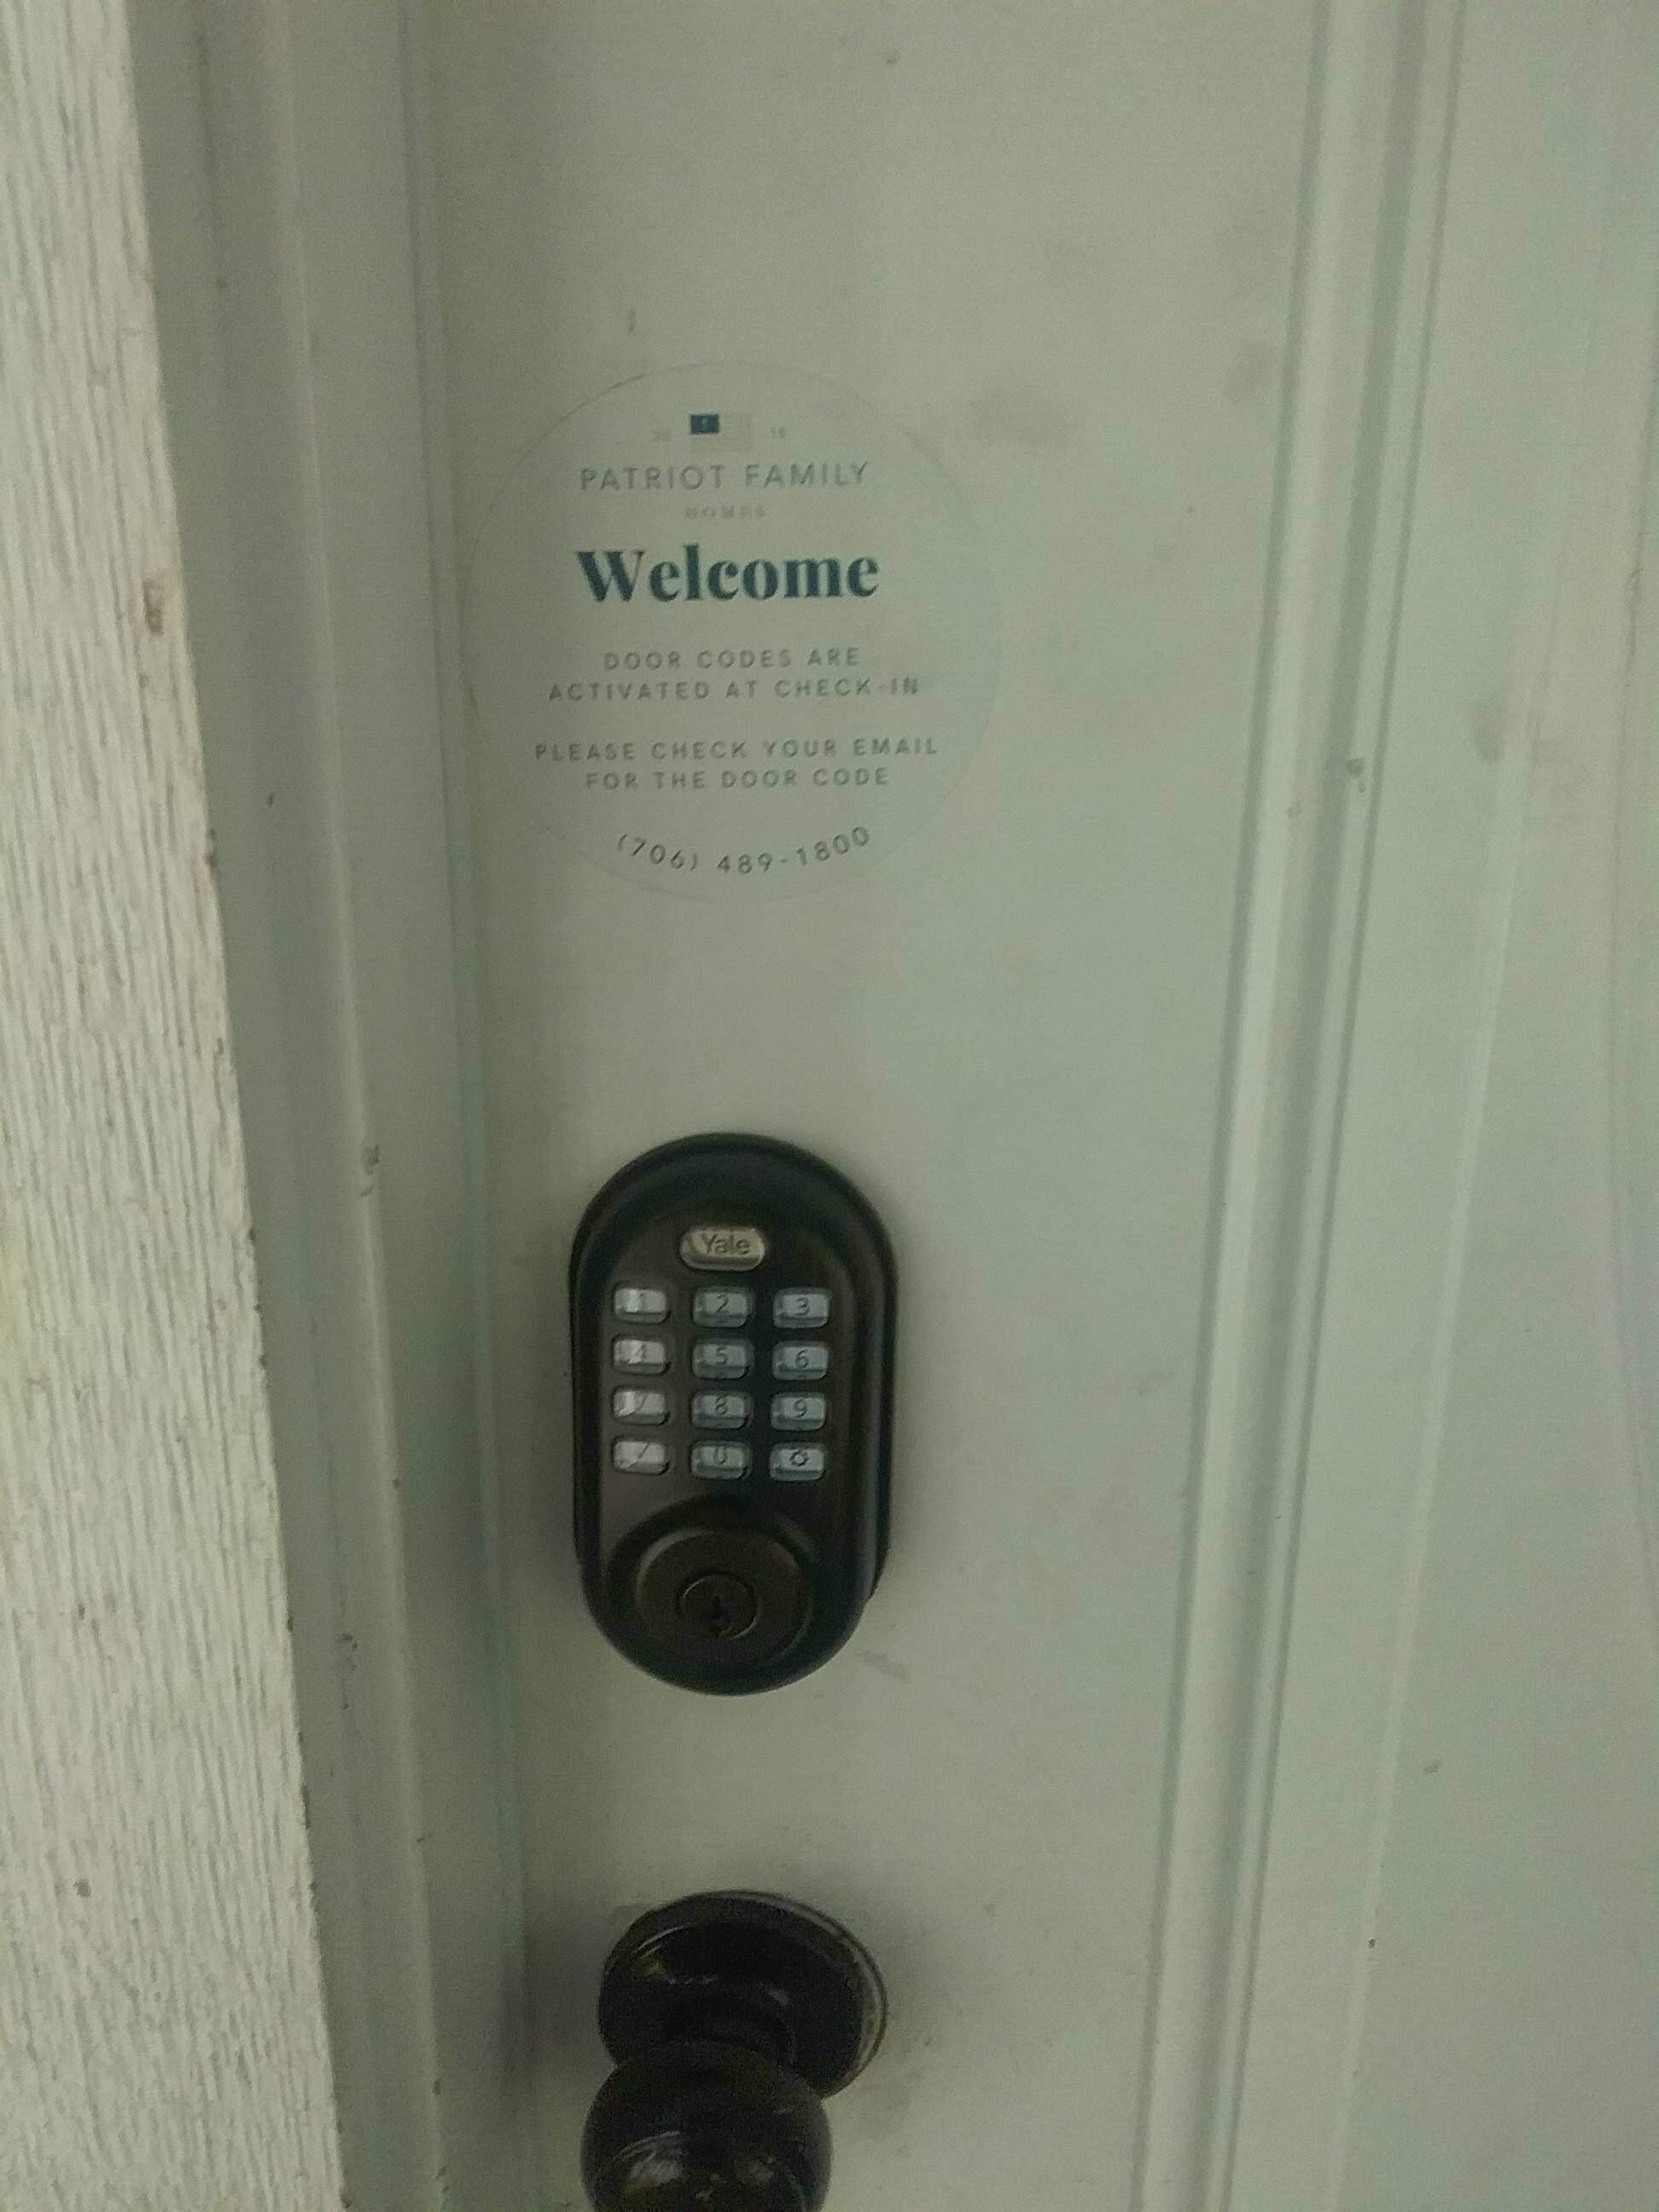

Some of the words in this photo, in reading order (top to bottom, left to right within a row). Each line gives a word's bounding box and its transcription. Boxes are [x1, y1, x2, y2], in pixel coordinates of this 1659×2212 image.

[579, 464, 726, 491] PATRIOT
[745, 461, 868, 488] FAMILY
[574, 542, 881, 602] Welcome
[603, 650, 681, 671] DOOR
[696, 648, 793, 669] CODES
[806, 646, 861, 667] ARE
[547, 681, 711, 702] ACTIVATED
[725, 679, 758, 699] AT
[773, 676, 920, 698] CHECK-IN
[533, 742, 636, 762] PLEASE
[650, 740, 748, 760] CHECK
[762, 738, 838, 758] YOUR
[853, 736, 940, 757] EMAIL
[585, 771, 639, 791] FOR
[653, 770, 706, 789] THE
[721, 769, 798, 789] DOOR
[812, 766, 891, 787] CODE
[616, 833, 700, 872] (706)
[716, 826, 871, 876] 489-1800
[701, 1232, 752, 1255] Yale
[715, 1293, 730, 1314] 2
[795, 1296, 811, 1317] 3
[714, 1346, 730, 1365] 5
[795, 1349, 810, 1370] 6
[714, 1395, 730, 1415] 8
[793, 1399, 809, 1418] 9
